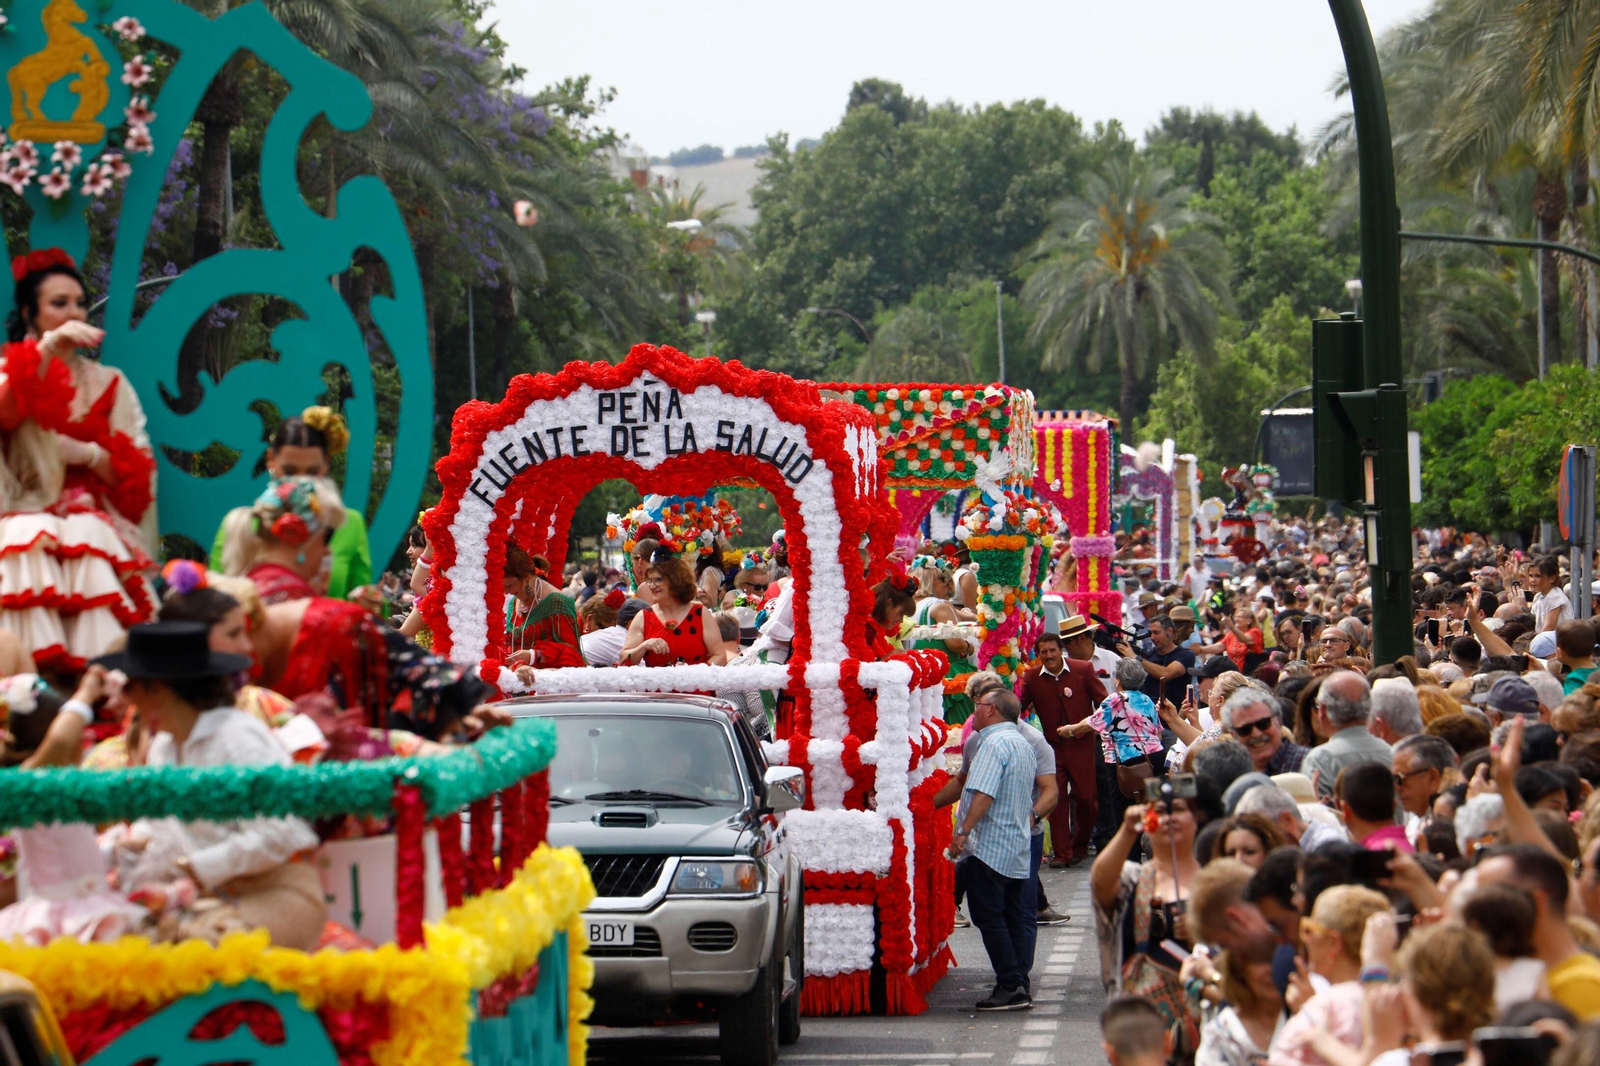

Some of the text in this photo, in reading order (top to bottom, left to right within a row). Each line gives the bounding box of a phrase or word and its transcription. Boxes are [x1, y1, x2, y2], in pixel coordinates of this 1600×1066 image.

[598, 379, 683, 425] PEÑA
[469, 419, 814, 508] FUENTE DE LA SALUD
[590, 924, 628, 942] BDY
